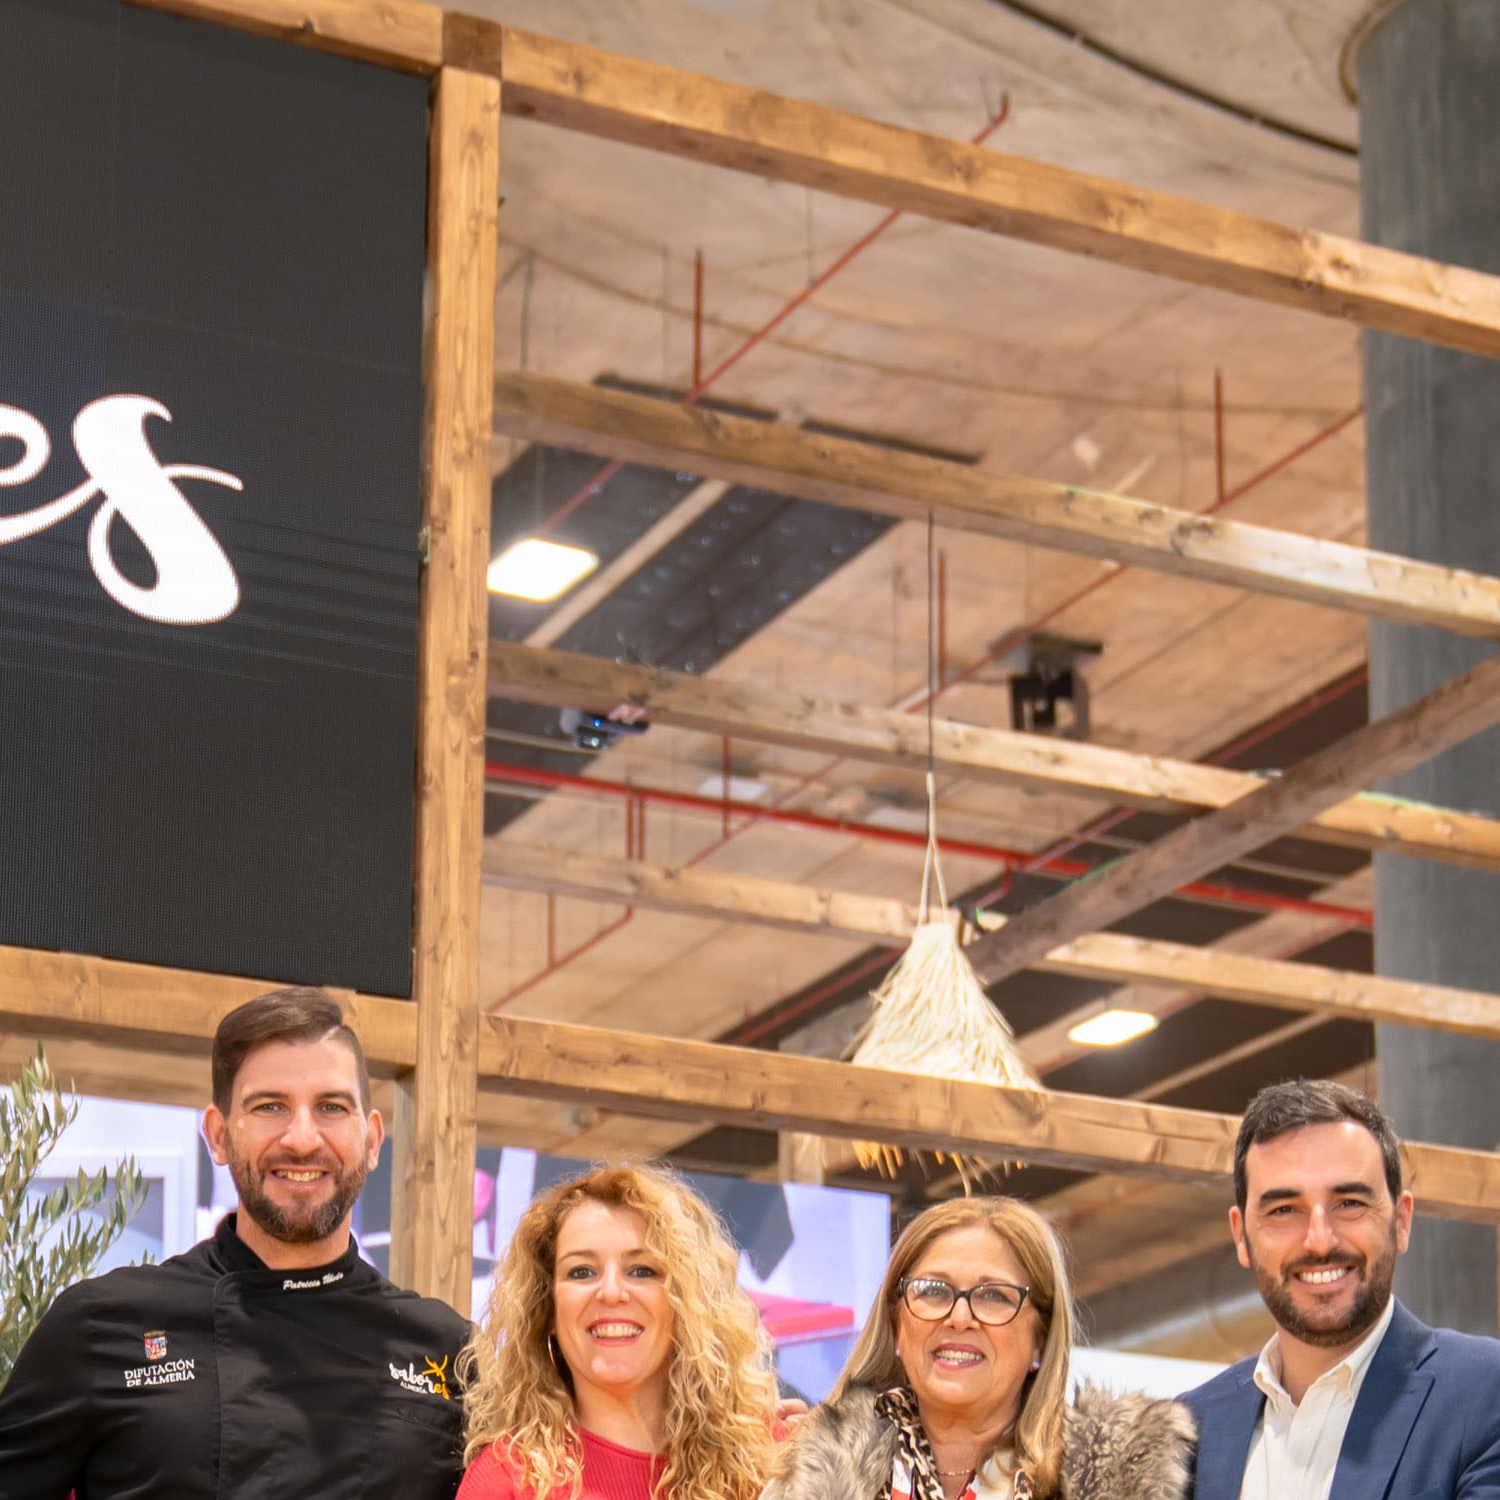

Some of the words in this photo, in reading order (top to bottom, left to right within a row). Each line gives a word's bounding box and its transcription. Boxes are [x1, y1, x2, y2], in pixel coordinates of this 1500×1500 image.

[124, 1359, 195, 1380] DIPUTACIÓN
[126, 1379, 142, 1388] DE
[144, 1369, 196, 1386] ALMERÍA
